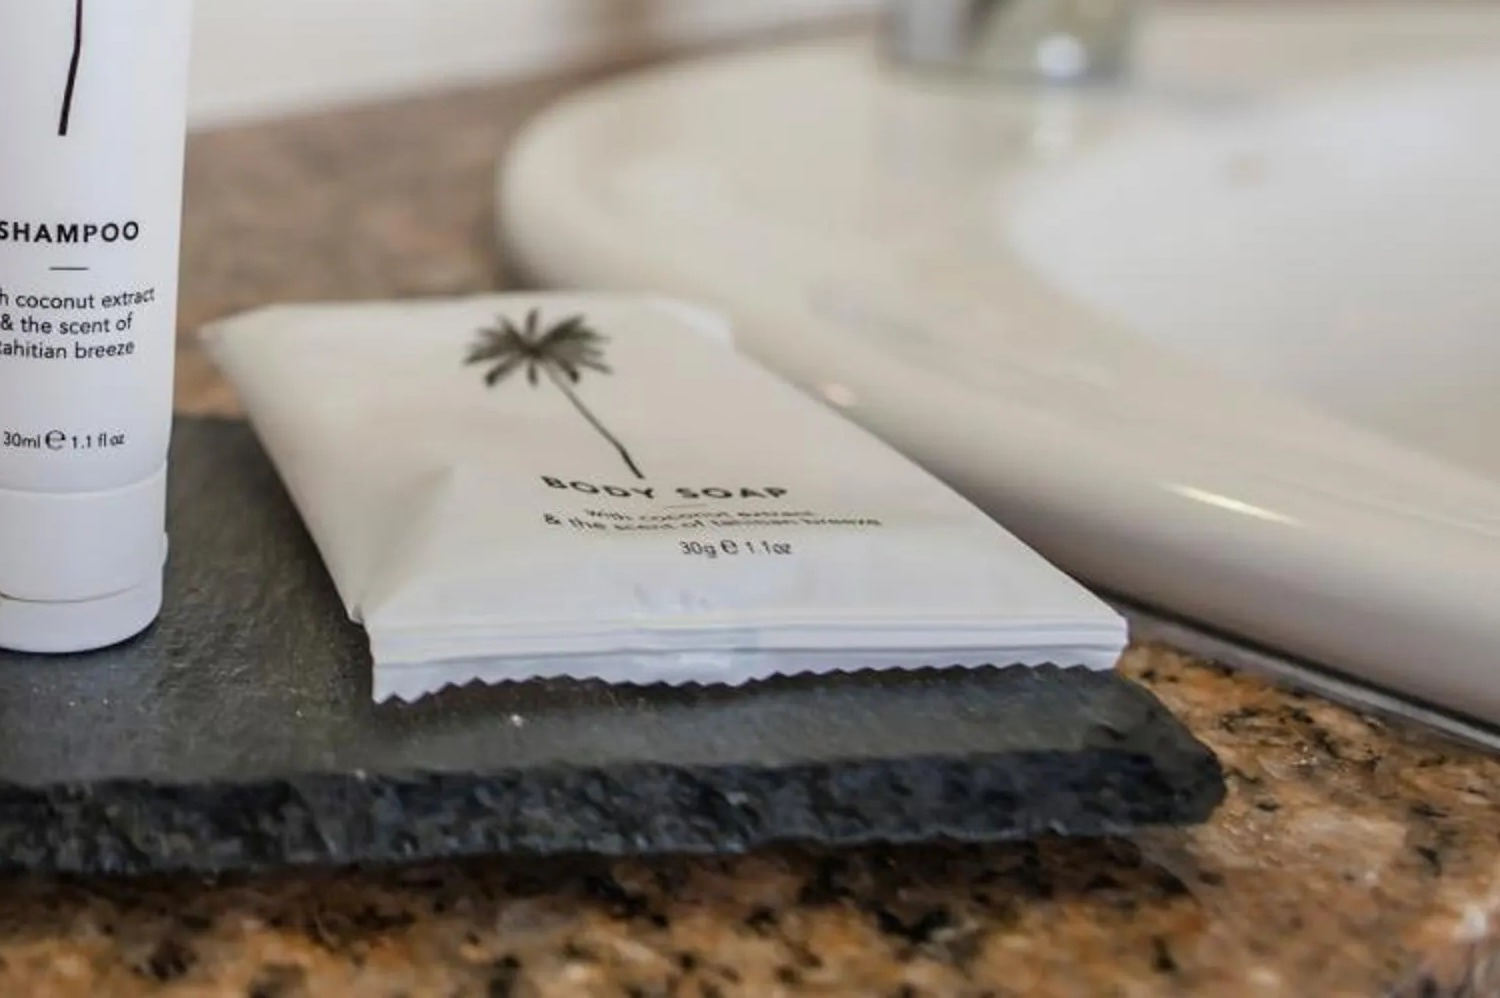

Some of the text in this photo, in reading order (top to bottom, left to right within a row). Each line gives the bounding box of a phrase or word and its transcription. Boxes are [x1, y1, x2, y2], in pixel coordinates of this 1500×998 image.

[14, 294, 95, 310] coconut
[101, 287, 155, 309] extract
[0, 310, 134, 336] & the scent of
[74, 340, 135, 360] breeze
[3, 430, 42, 449] 30ml
[71, 434, 92, 450] 1.1
[97, 431, 108, 448] fl
[109, 433, 126, 447] oz
[540, 473, 788, 500] BODY SOAP
[679, 540, 717, 559] 30g
